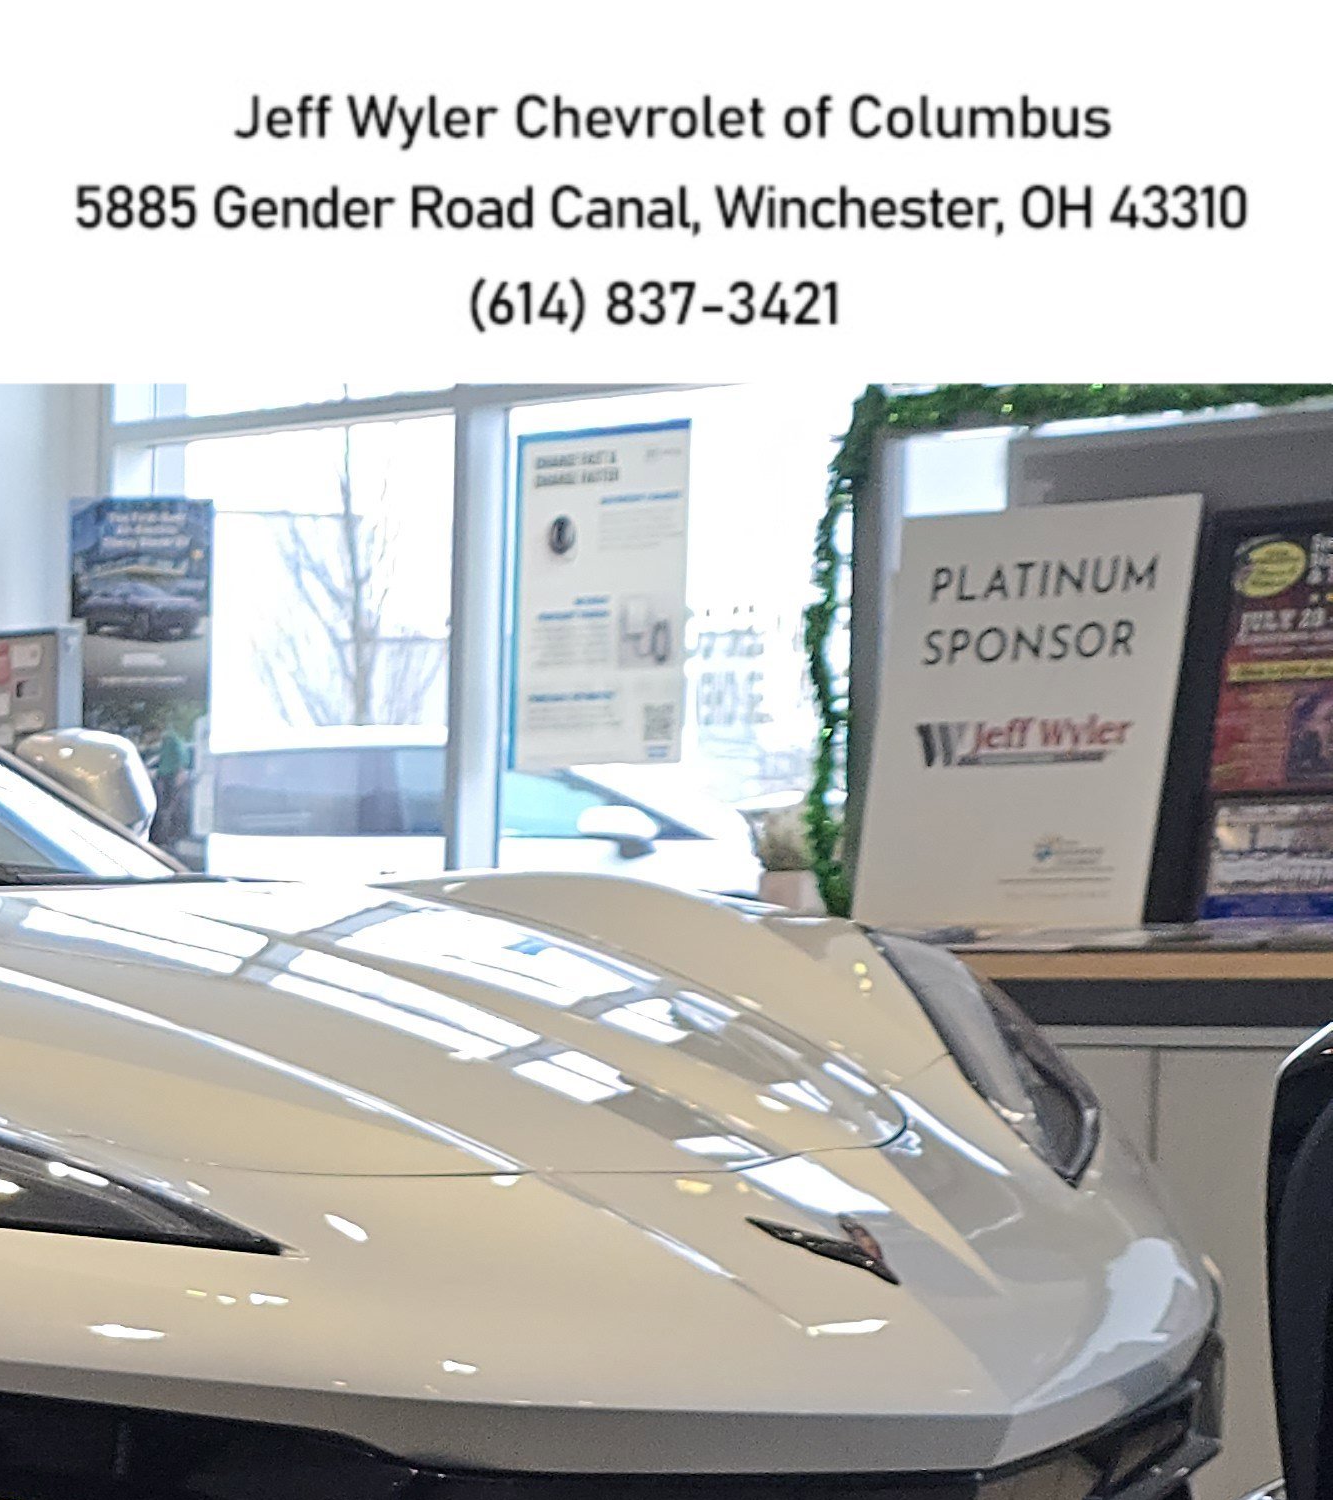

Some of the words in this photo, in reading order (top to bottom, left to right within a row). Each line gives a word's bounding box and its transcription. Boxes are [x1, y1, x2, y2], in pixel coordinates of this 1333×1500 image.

[930, 554, 1159, 603] PLATINUM
[922, 618, 1135, 666] SPONSOR
[972, 716, 1034, 754] Jeff
[1039, 713, 1134, 758] Wyler
